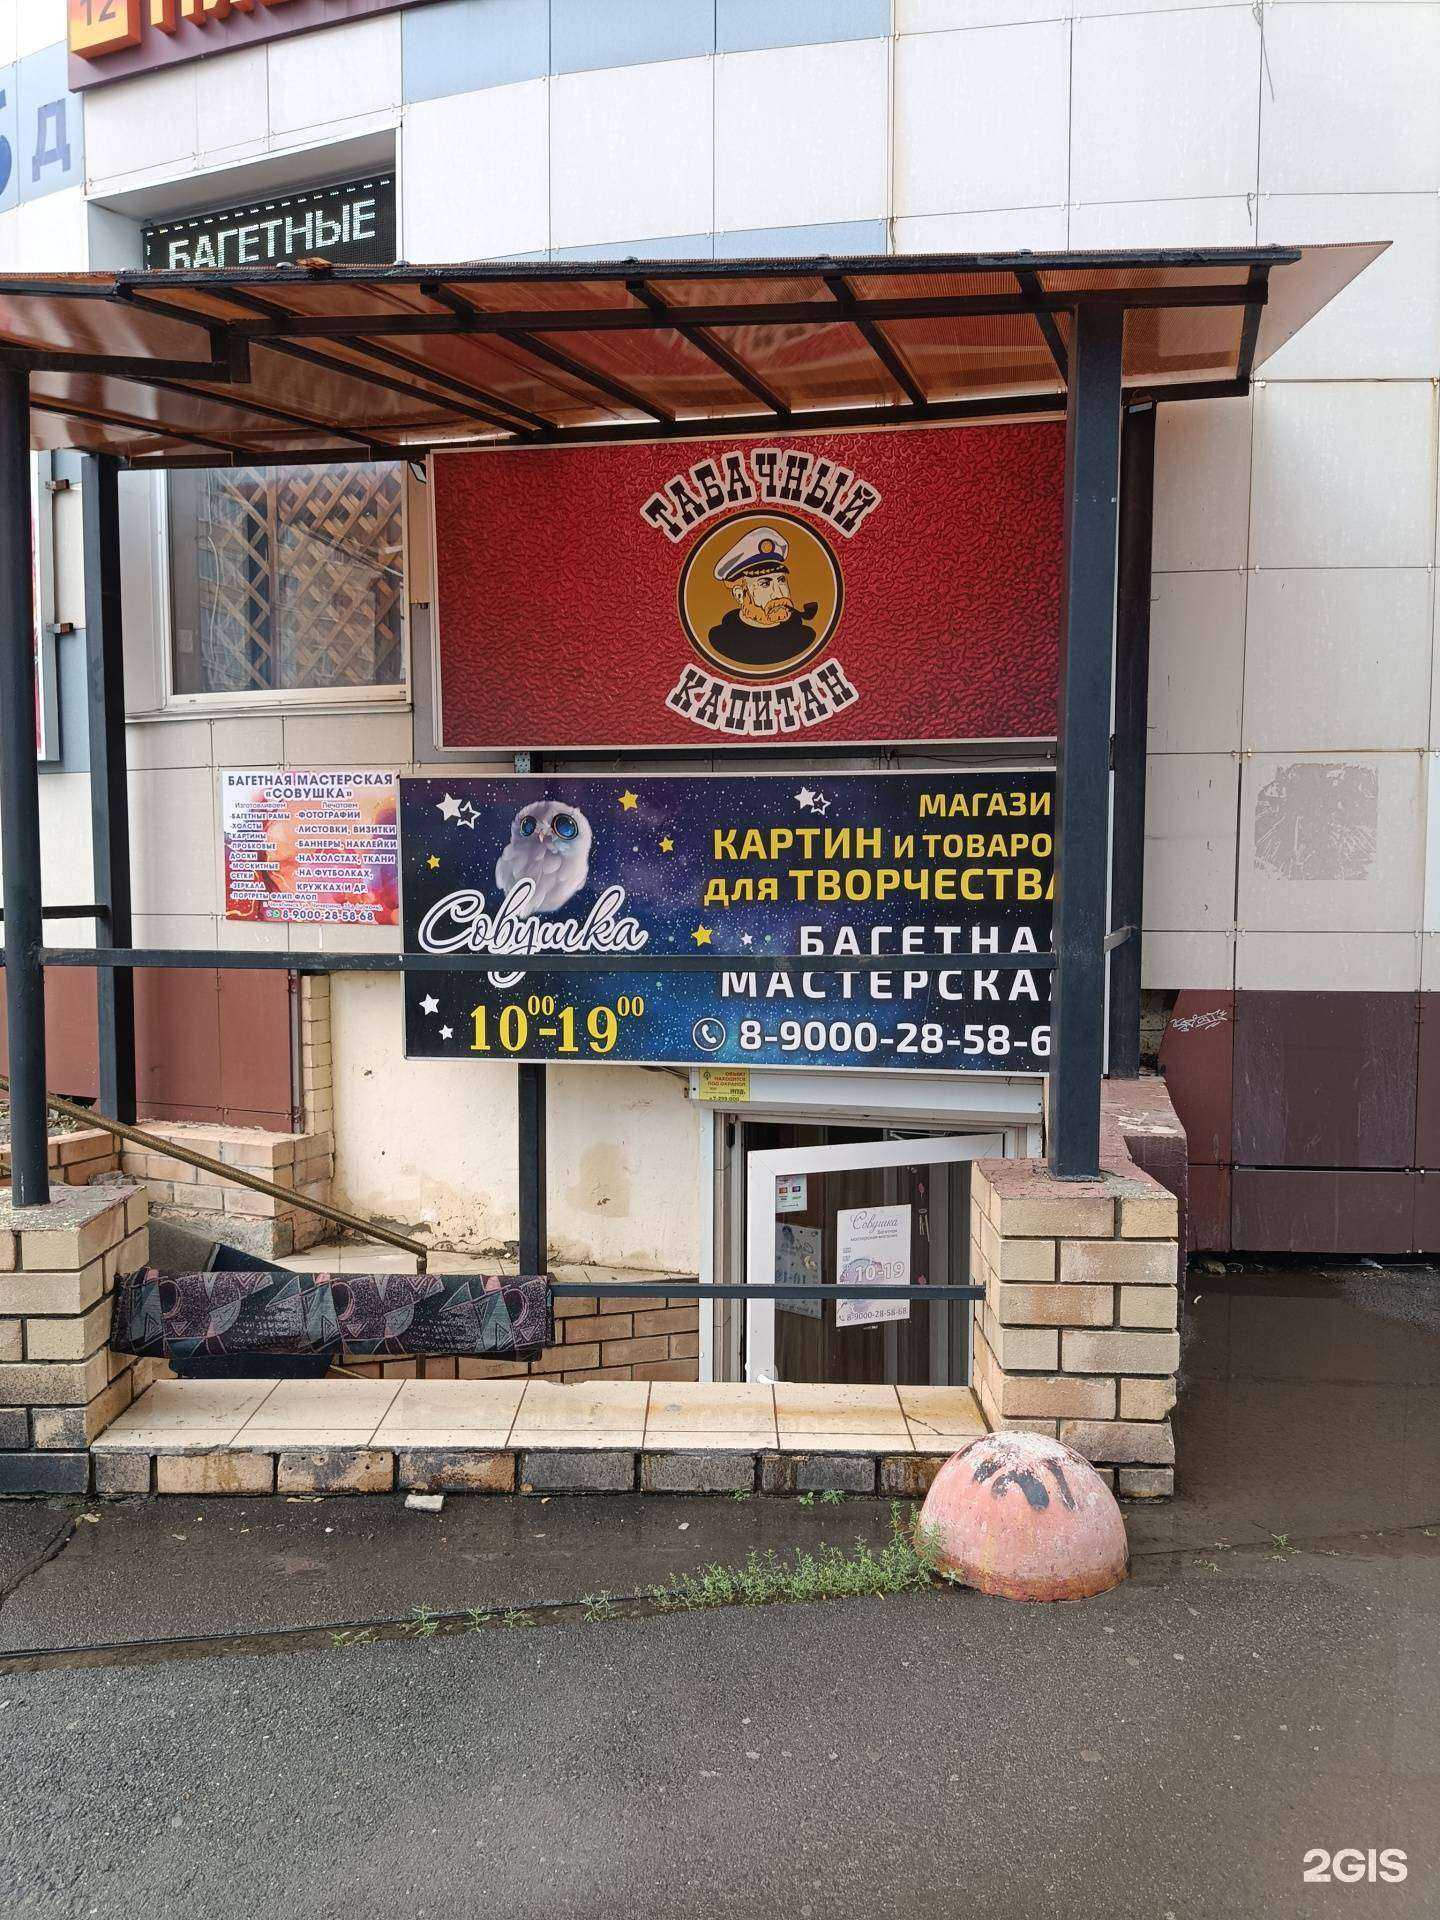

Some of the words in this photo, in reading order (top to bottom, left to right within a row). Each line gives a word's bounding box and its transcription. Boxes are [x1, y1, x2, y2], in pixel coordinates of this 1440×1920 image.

[168, 199, 376, 269] БАГЕТНЫЕ
[642, 450, 880, 541] ТАБАЧНЫЙ
[667, 660, 857, 733] КАПИТАН
[228, 775, 292, 786] БАГЕТНАЯ
[297, 774, 392, 785] МАСТЕРСКАЯ
[919, 792, 1052, 818] МАГАЗИ
[346, 839, 397, 848] НАКЛЕЙКИ
[713, 827, 881, 860] КАРТИН
[922, 833, 1053, 859] ТОВАРО
[703, 878, 778, 907] для
[418, 877, 650, 989] Совушка
[799, 925, 1053, 956] БАГЕТНА
[721, 971, 1053, 1001] МАСТЕРСКА
[740, 1020, 1051, 1057] 8-9000-28-58-6
[855, 1262, 905, 1282] 10-19
